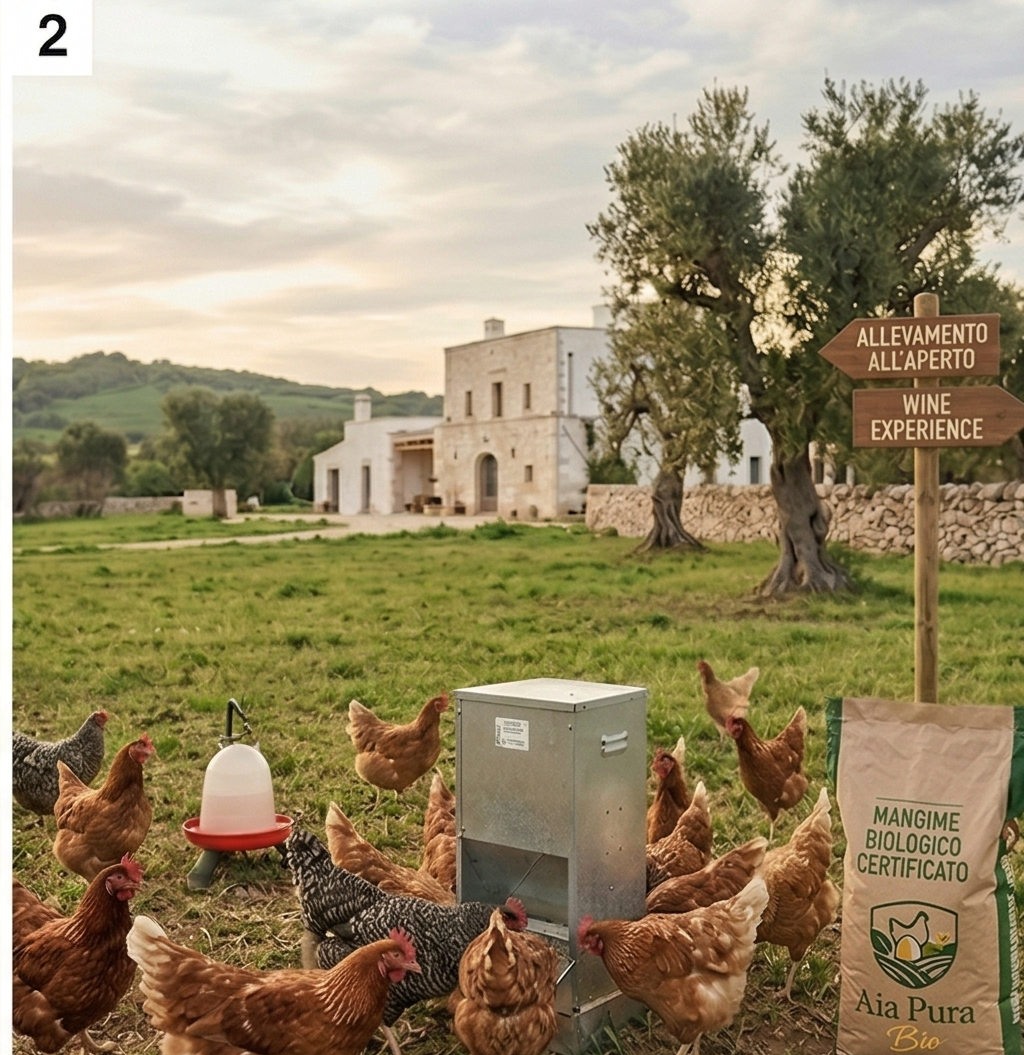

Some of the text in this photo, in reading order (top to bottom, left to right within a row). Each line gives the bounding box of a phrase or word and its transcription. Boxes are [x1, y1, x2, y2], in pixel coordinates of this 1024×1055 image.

[857, 323, 988, 347] ALLEVAMENTO
[868, 348, 975, 371] ALL'APERTO
[903, 393, 951, 415] WINE
[871, 418, 983, 440] EXPERIENCE
[873, 805, 960, 832] MANGIME
[866, 829, 962, 857] BIOLOGICO
[857, 853, 969, 883] CERTIFICATO
[855, 989, 976, 1024] Aia Pura
[887, 1025, 946, 1051] Bio
